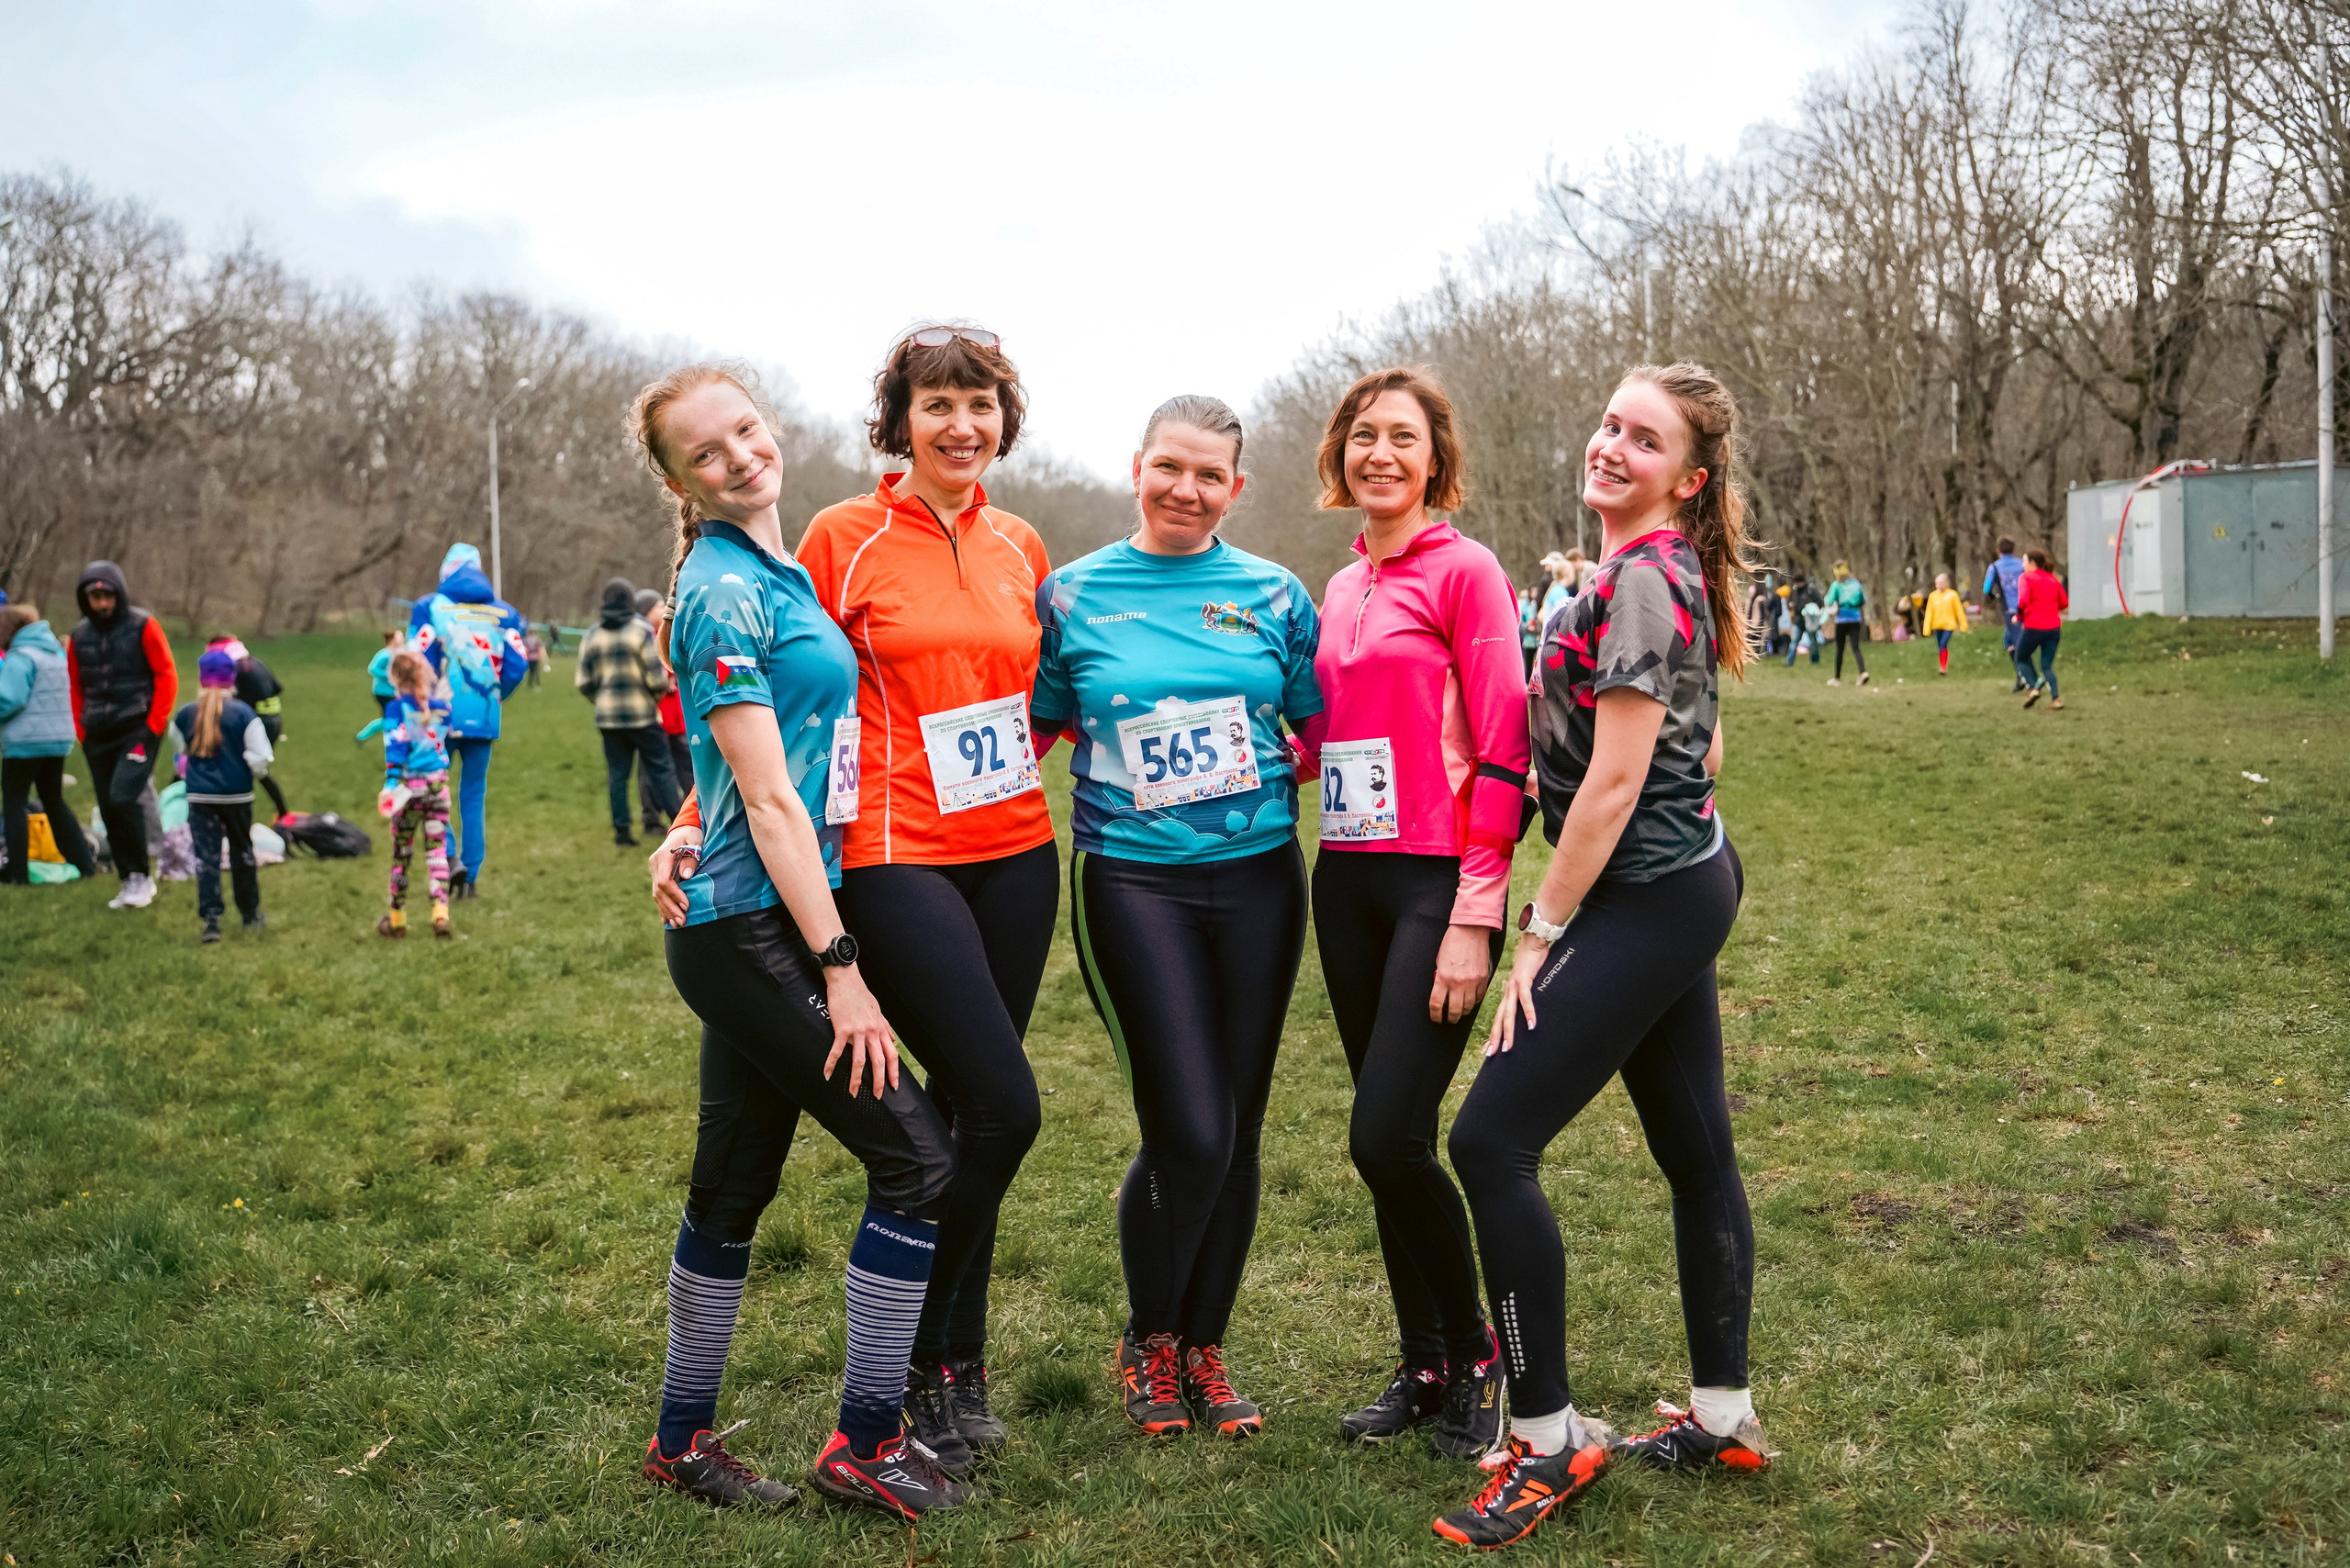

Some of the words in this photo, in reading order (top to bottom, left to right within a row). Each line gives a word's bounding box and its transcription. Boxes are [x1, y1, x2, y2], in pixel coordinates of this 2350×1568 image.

[1087, 611, 1147, 625] noname
[929, 716, 964, 730] ВСЕРОССИЙСКИЕ
[1125, 719, 1159, 733] ВСЕРОССИЙСКИЕ
[1143, 722, 1173, 734] СПОРТИВНОМУ
[957, 725, 1006, 777] 92
[1139, 726, 1218, 783] 565
[942, 783, 961, 791] Памяти
[961, 777, 982, 788] военного
[1155, 779, 1176, 789] военного
[1177, 775, 1203, 786] топографа
[1324, 766, 1347, 812] 82
[1537, 946, 1575, 992] NORDSKI
[867, 1222, 935, 1249] noname
[835, 1465, 874, 1494] BOLD
[1536, 1495, 1556, 1508] BOLD
